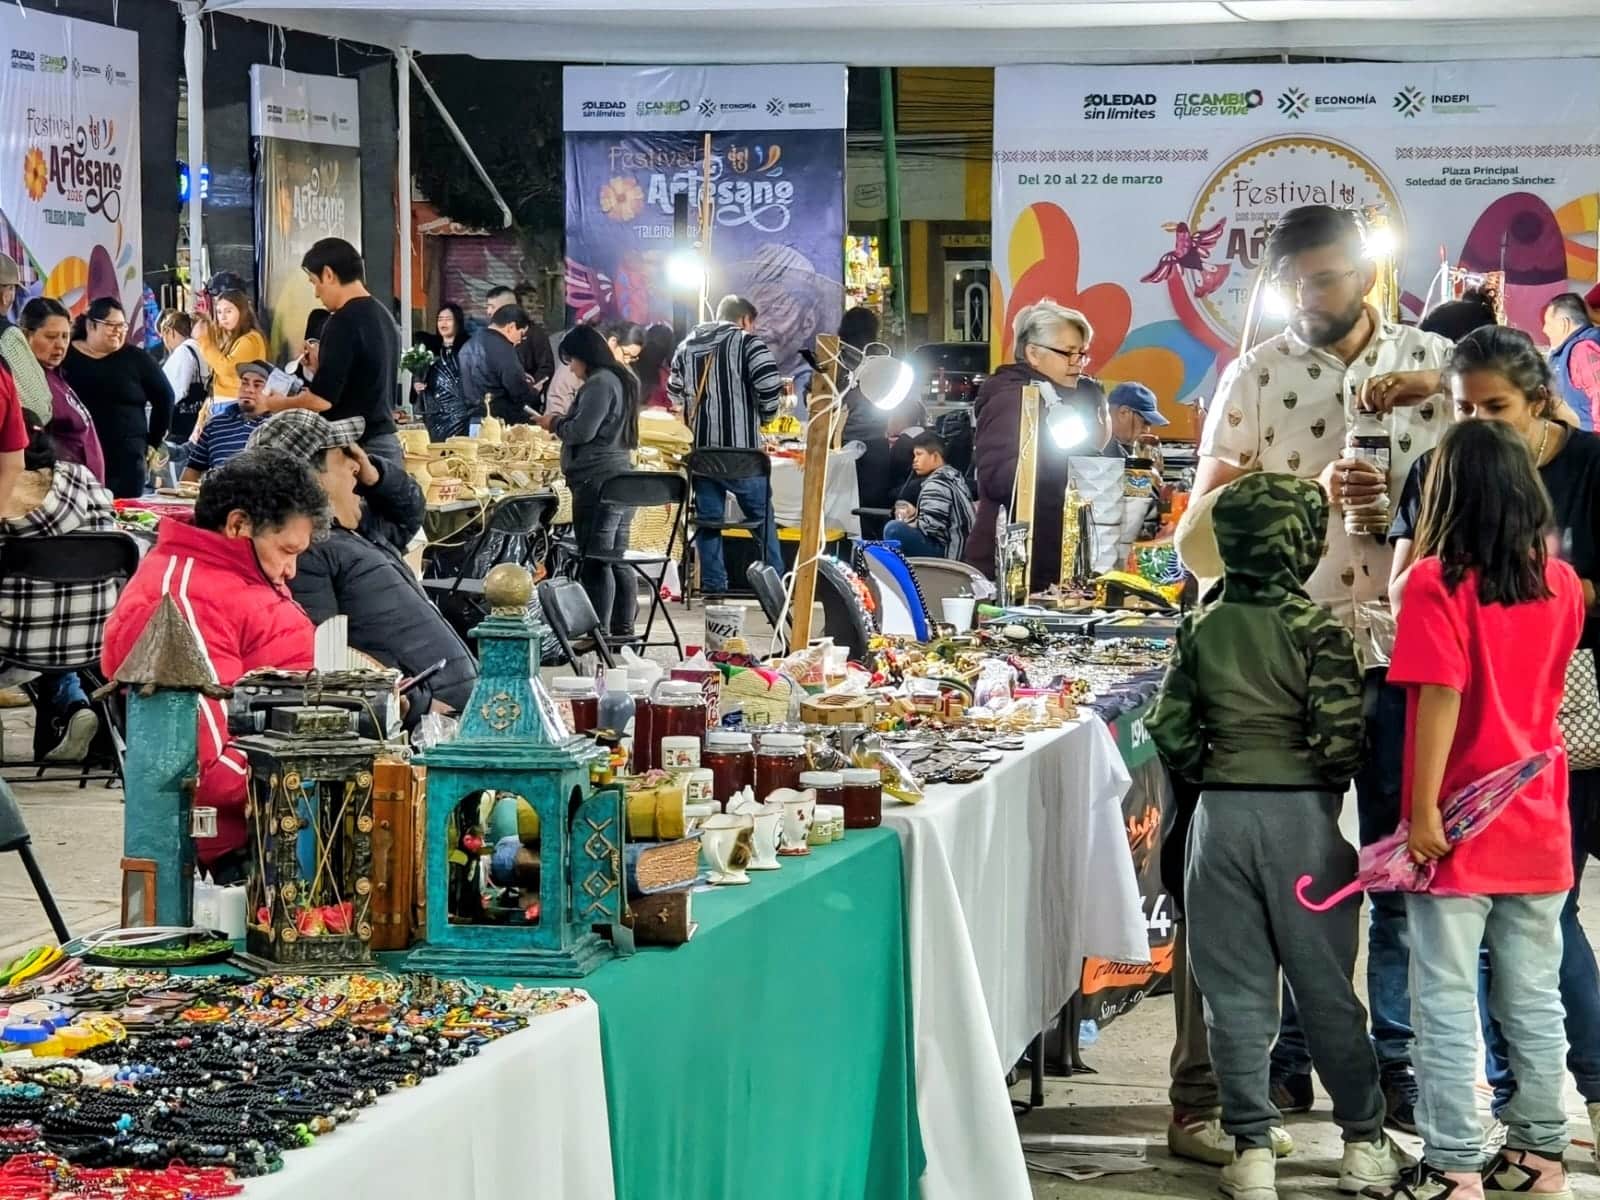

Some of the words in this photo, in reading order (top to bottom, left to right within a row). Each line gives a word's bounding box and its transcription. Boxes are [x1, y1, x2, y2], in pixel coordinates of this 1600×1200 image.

[1083, 93, 1157, 108] SOLEDAD
[1188, 89, 1263, 108] CAMBIO
[1314, 94, 1377, 105] ECONOMÍA
[1431, 94, 1470, 104] INDEPI
[1084, 107, 1106, 120] sin
[1107, 107, 1156, 120] límites
[1174, 106, 1201, 120] que
[1202, 106, 1217, 116] se
[1220, 105, 1249, 116] vive
[27, 108, 75, 141] Festival
[1442, 166, 1471, 176] Plaza
[1473, 165, 1519, 177] Principal
[1018, 173, 1040, 185] Del
[1044, 174, 1062, 185] 20
[1065, 173, 1077, 185] al
[1081, 174, 1099, 185] 22
[1102, 173, 1118, 185] de
[1121, 175, 1163, 185] marzo
[1405, 177, 1447, 186] Soledad
[1450, 177, 1462, 186] de
[1465, 176, 1510, 186] Graciano
[1512, 175, 1556, 185] Sánchez
[1233, 179, 1335, 207] Festival
